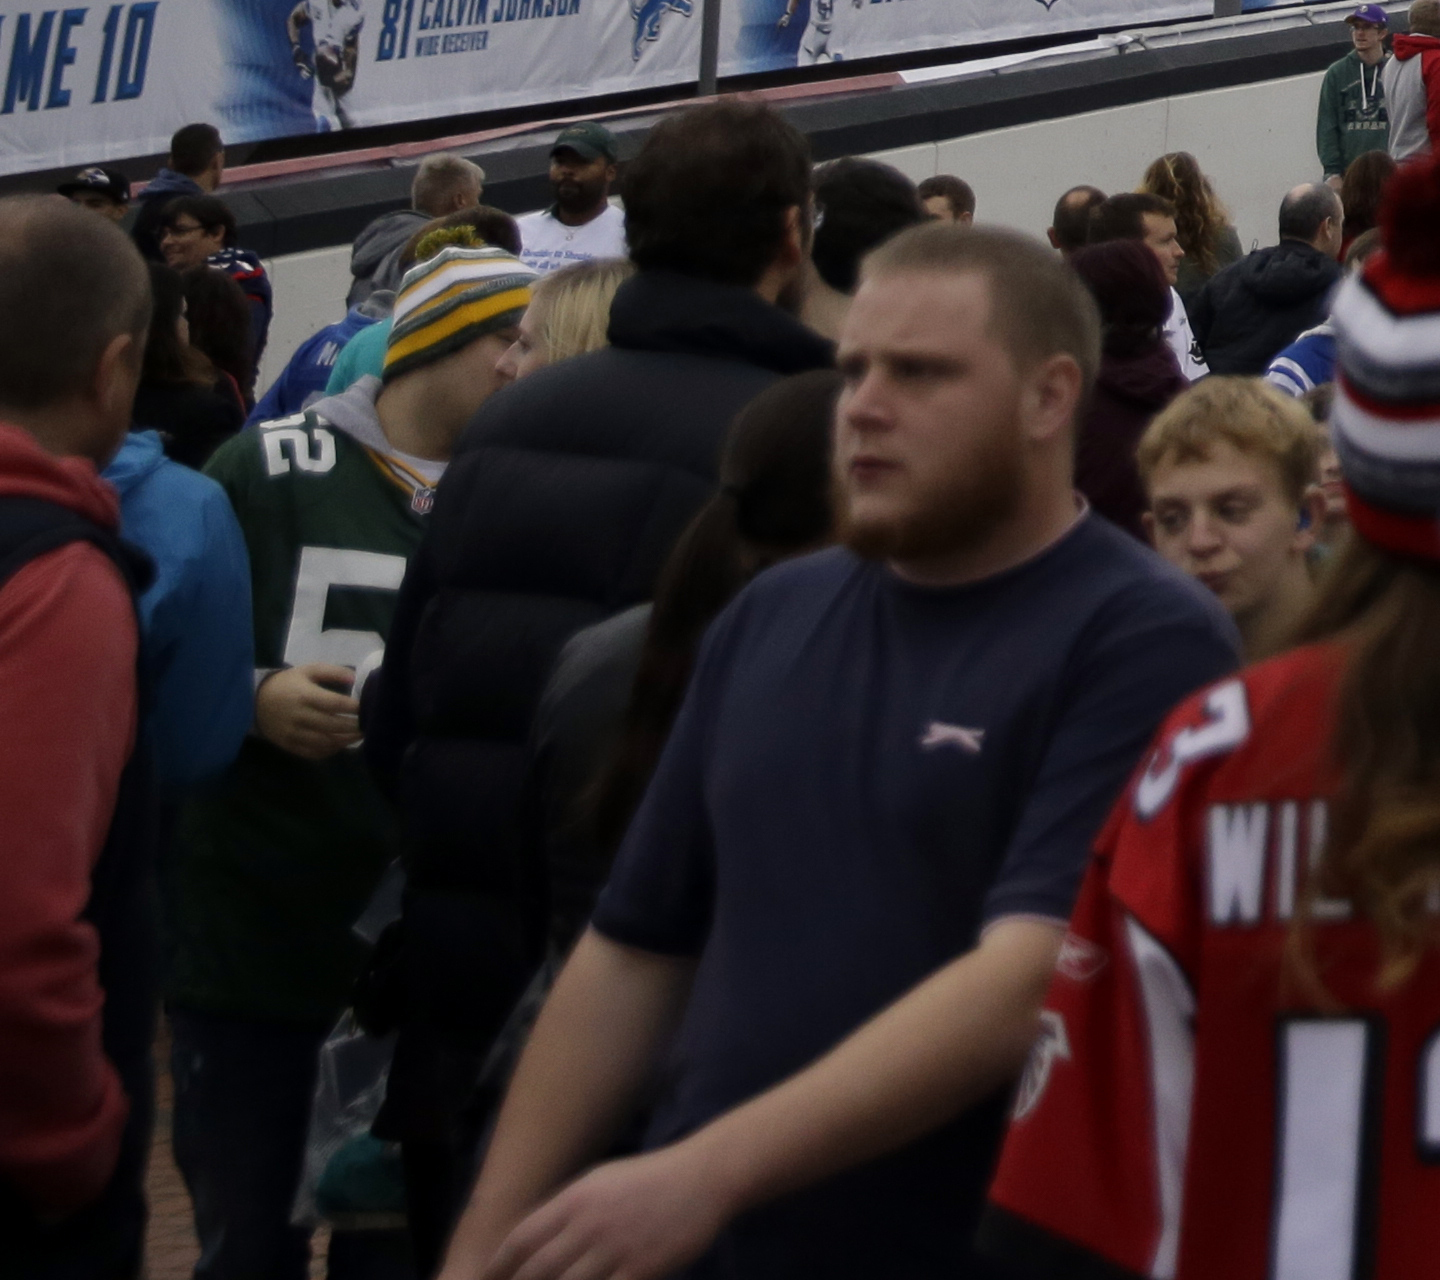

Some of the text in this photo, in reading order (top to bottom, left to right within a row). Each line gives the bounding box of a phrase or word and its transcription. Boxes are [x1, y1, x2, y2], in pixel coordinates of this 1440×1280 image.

[0, 0, 160, 115] ME 10
[415, 30, 489, 57] WIDE RECEIVER
